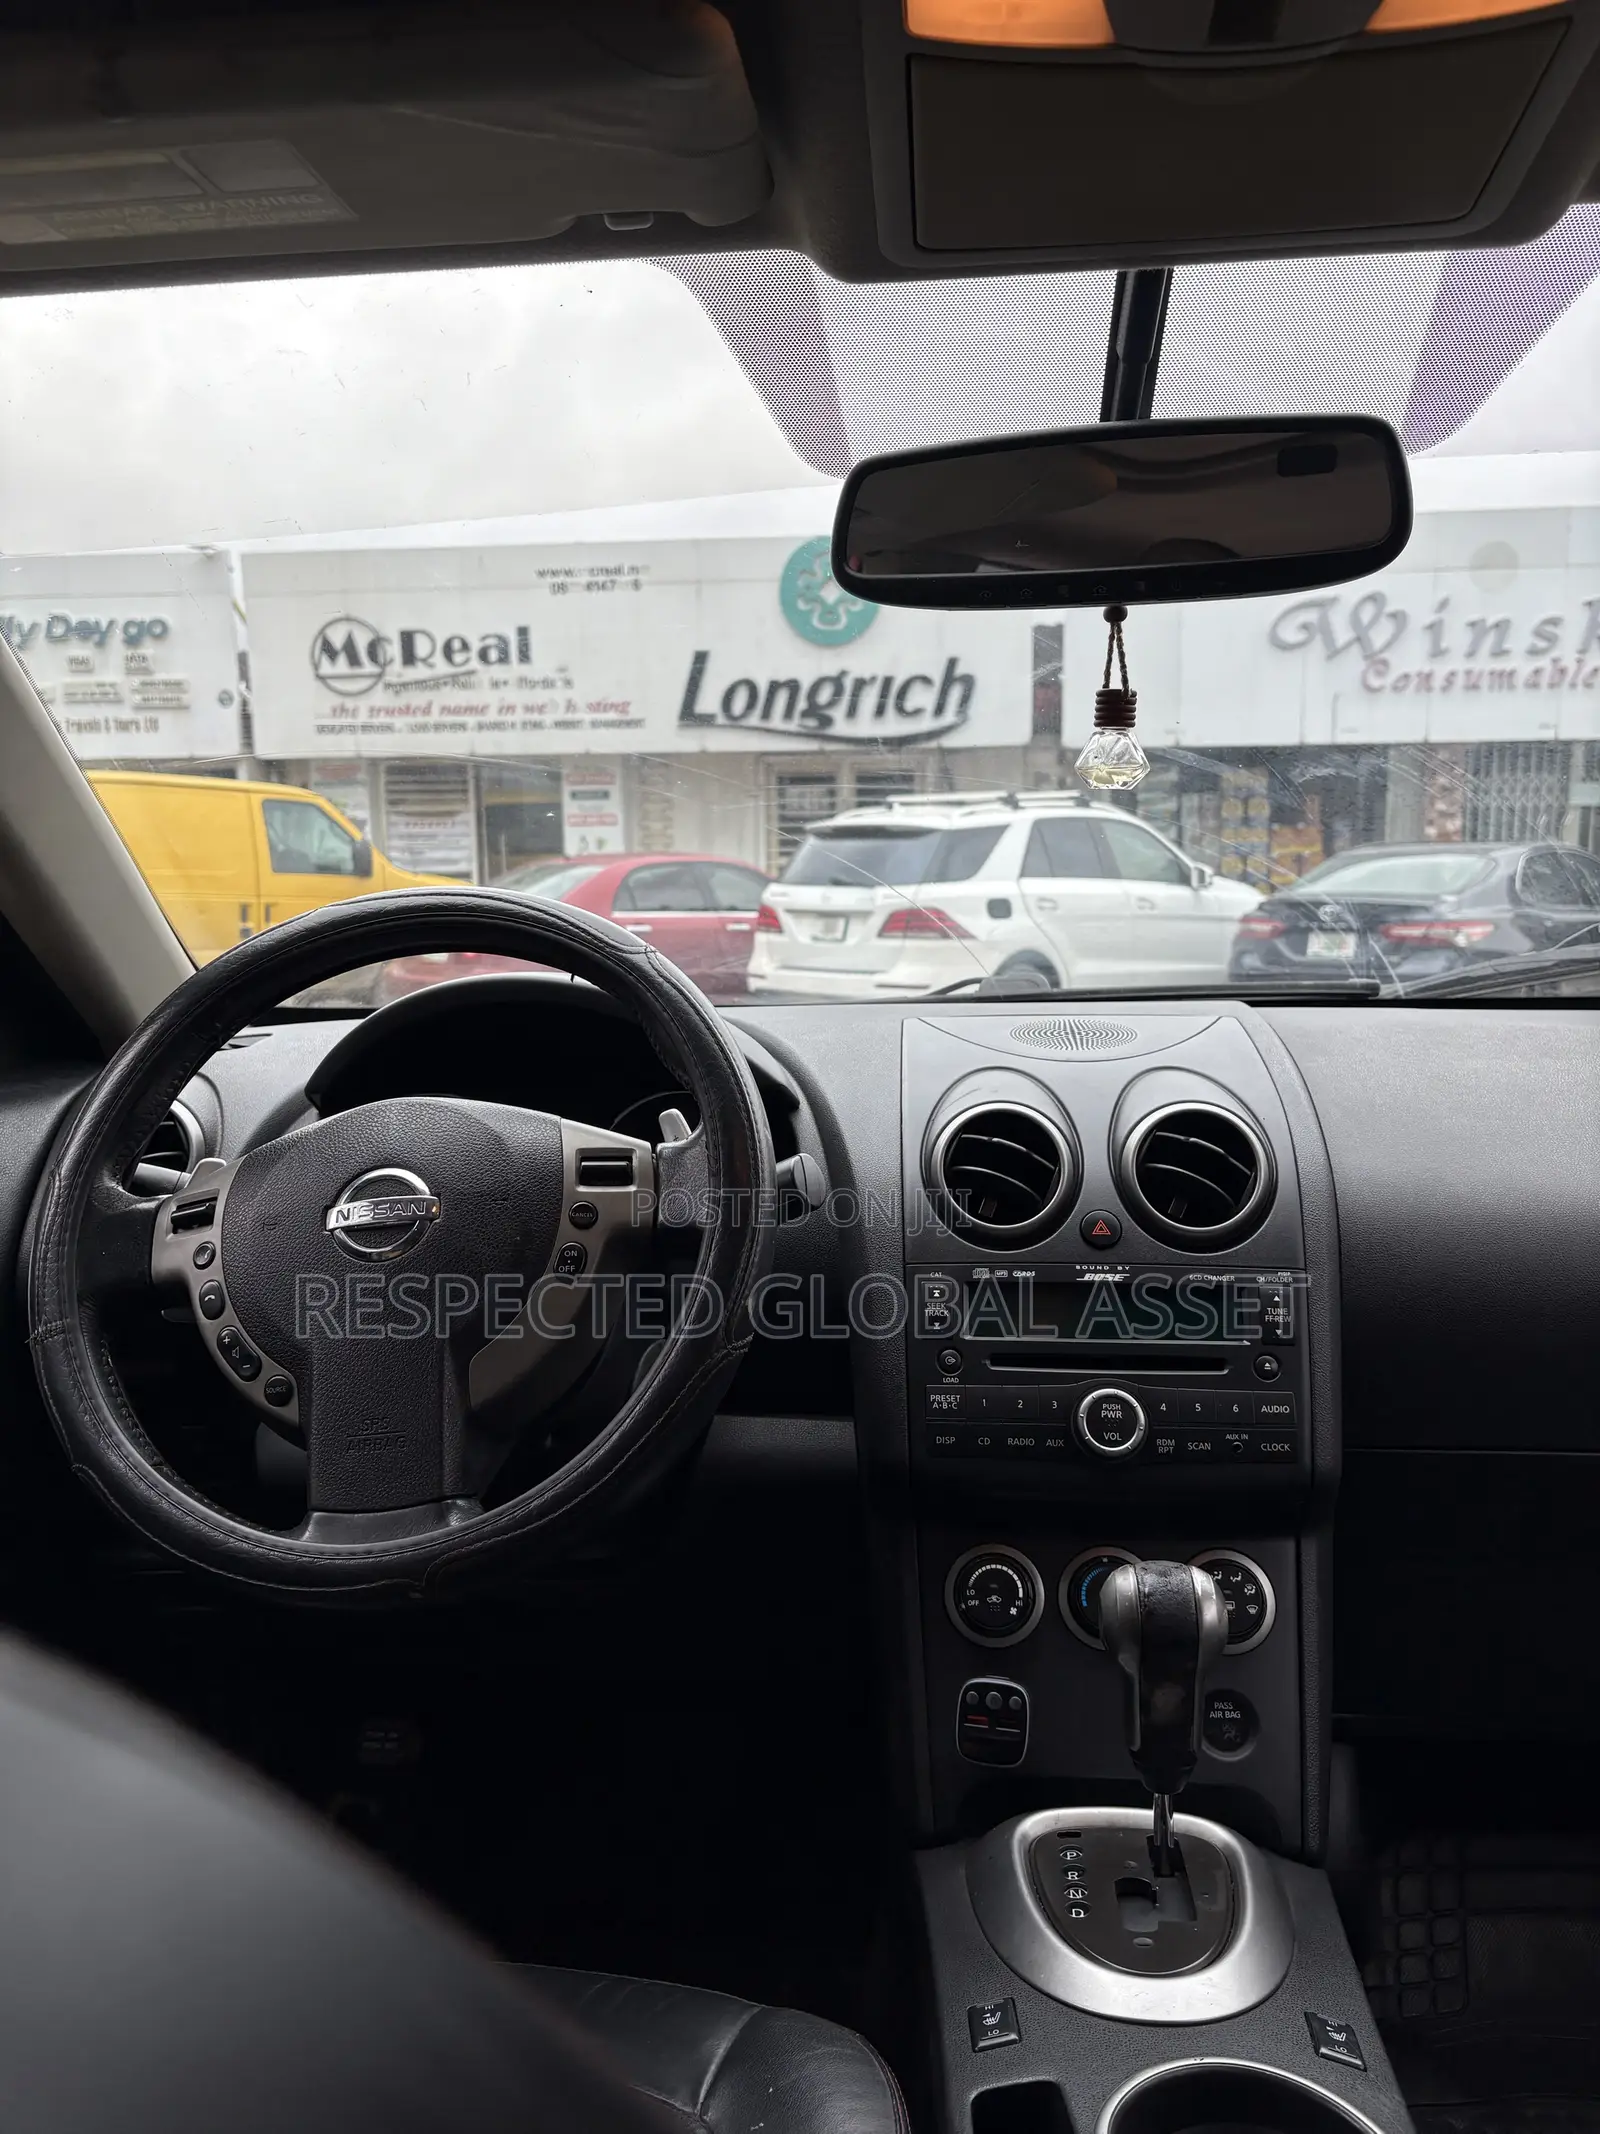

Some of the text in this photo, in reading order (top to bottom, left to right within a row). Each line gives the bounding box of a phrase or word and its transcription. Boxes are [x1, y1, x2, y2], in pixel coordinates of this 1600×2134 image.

[122, 616, 170, 646] go
[317, 624, 532, 670] McReal
[678, 650, 975, 729] Longrich
[440, 704, 490, 717] name
[497, 699, 517, 716] in
[334, 1201, 427, 1226] NISSAN
[558, 1265, 576, 1273] OFF
[1076, 1273, 1130, 1281] BOSE
[926, 1302, 946, 1310] SEEK
[924, 1309, 949, 1317] TRACK
[1266, 1307, 1288, 1315] TUNE
[930, 1394, 960, 1402] PRESET
[1160, 1403, 1167, 1411] 4
[1195, 1403, 1201, 1412] 5
[1232, 1404, 1239, 1412] 6
[1261, 1405, 1290, 1414] AUDIO
[1101, 1410, 1122, 1418] PWR
[935, 1436, 956, 1444] DISP
[1103, 1432, 1122, 1440] VOL
[1007, 1438, 1035, 1446] RADIO
[1045, 1439, 1064, 1447] AUX
[1156, 1438, 1175, 1446] RDM
[1187, 1442, 1211, 1450] SCAN
[1158, 1446, 1174, 1454] RPT
[1261, 1443, 1290, 1451] CLOCK
[1214, 1701, 1233, 1709] PASS
[1209, 1710, 1241, 1718] AIR BAG
[1067, 1871, 1078, 1880] R
[1069, 1889, 1082, 1898] N
[1072, 1908, 1085, 1917] D
